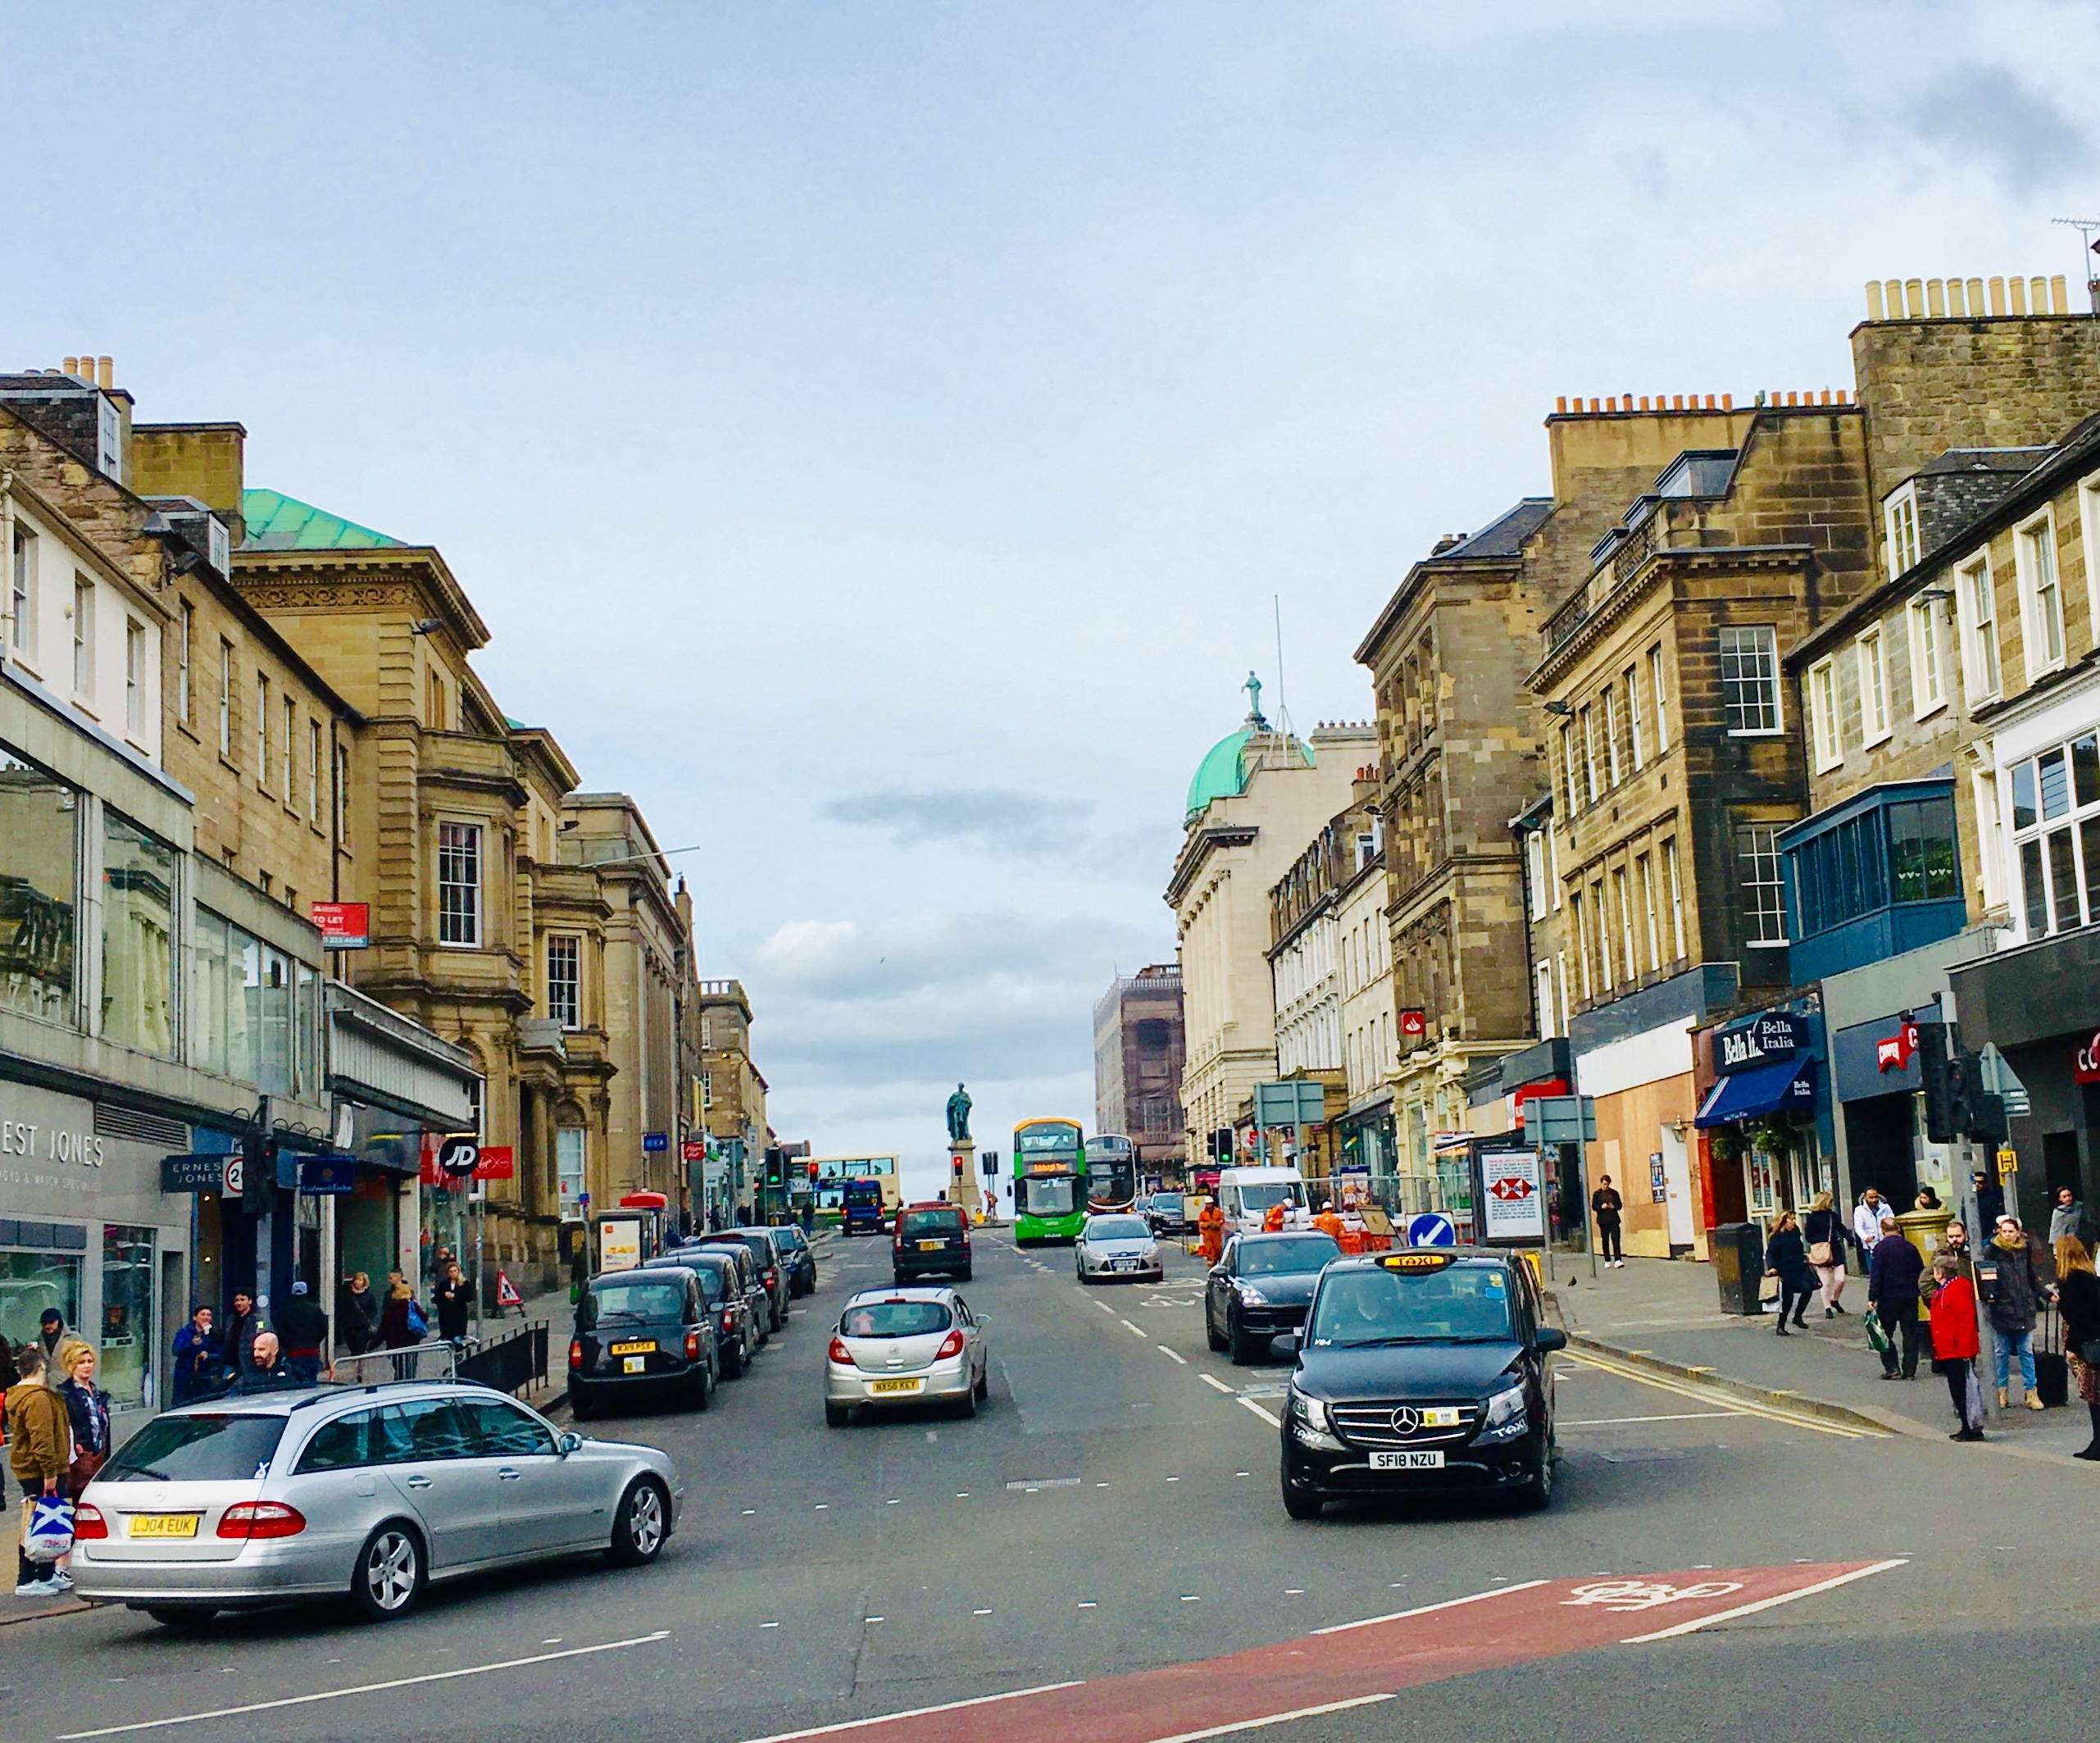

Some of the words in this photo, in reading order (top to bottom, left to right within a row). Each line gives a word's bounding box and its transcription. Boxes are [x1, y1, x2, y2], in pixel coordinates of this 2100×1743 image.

[327, 916, 344, 924] LET
[1761, 1020, 1793, 1034] Bella
[1722, 1033, 1748, 1066] Bella
[1762, 1036, 1795, 1049] Italia
[49, 1130, 104, 1167] JONES
[445, 1145, 476, 1166] JD
[1398, 1256, 1434, 1267] TAXI
[1293, 1423, 1323, 1444] TAXI
[1490, 1418, 1526, 1437] TAXI
[1377, 1454, 1407, 1468] SF18
[1410, 1454, 1437, 1467] NZU
[166, 1518, 192, 1532] EUK
